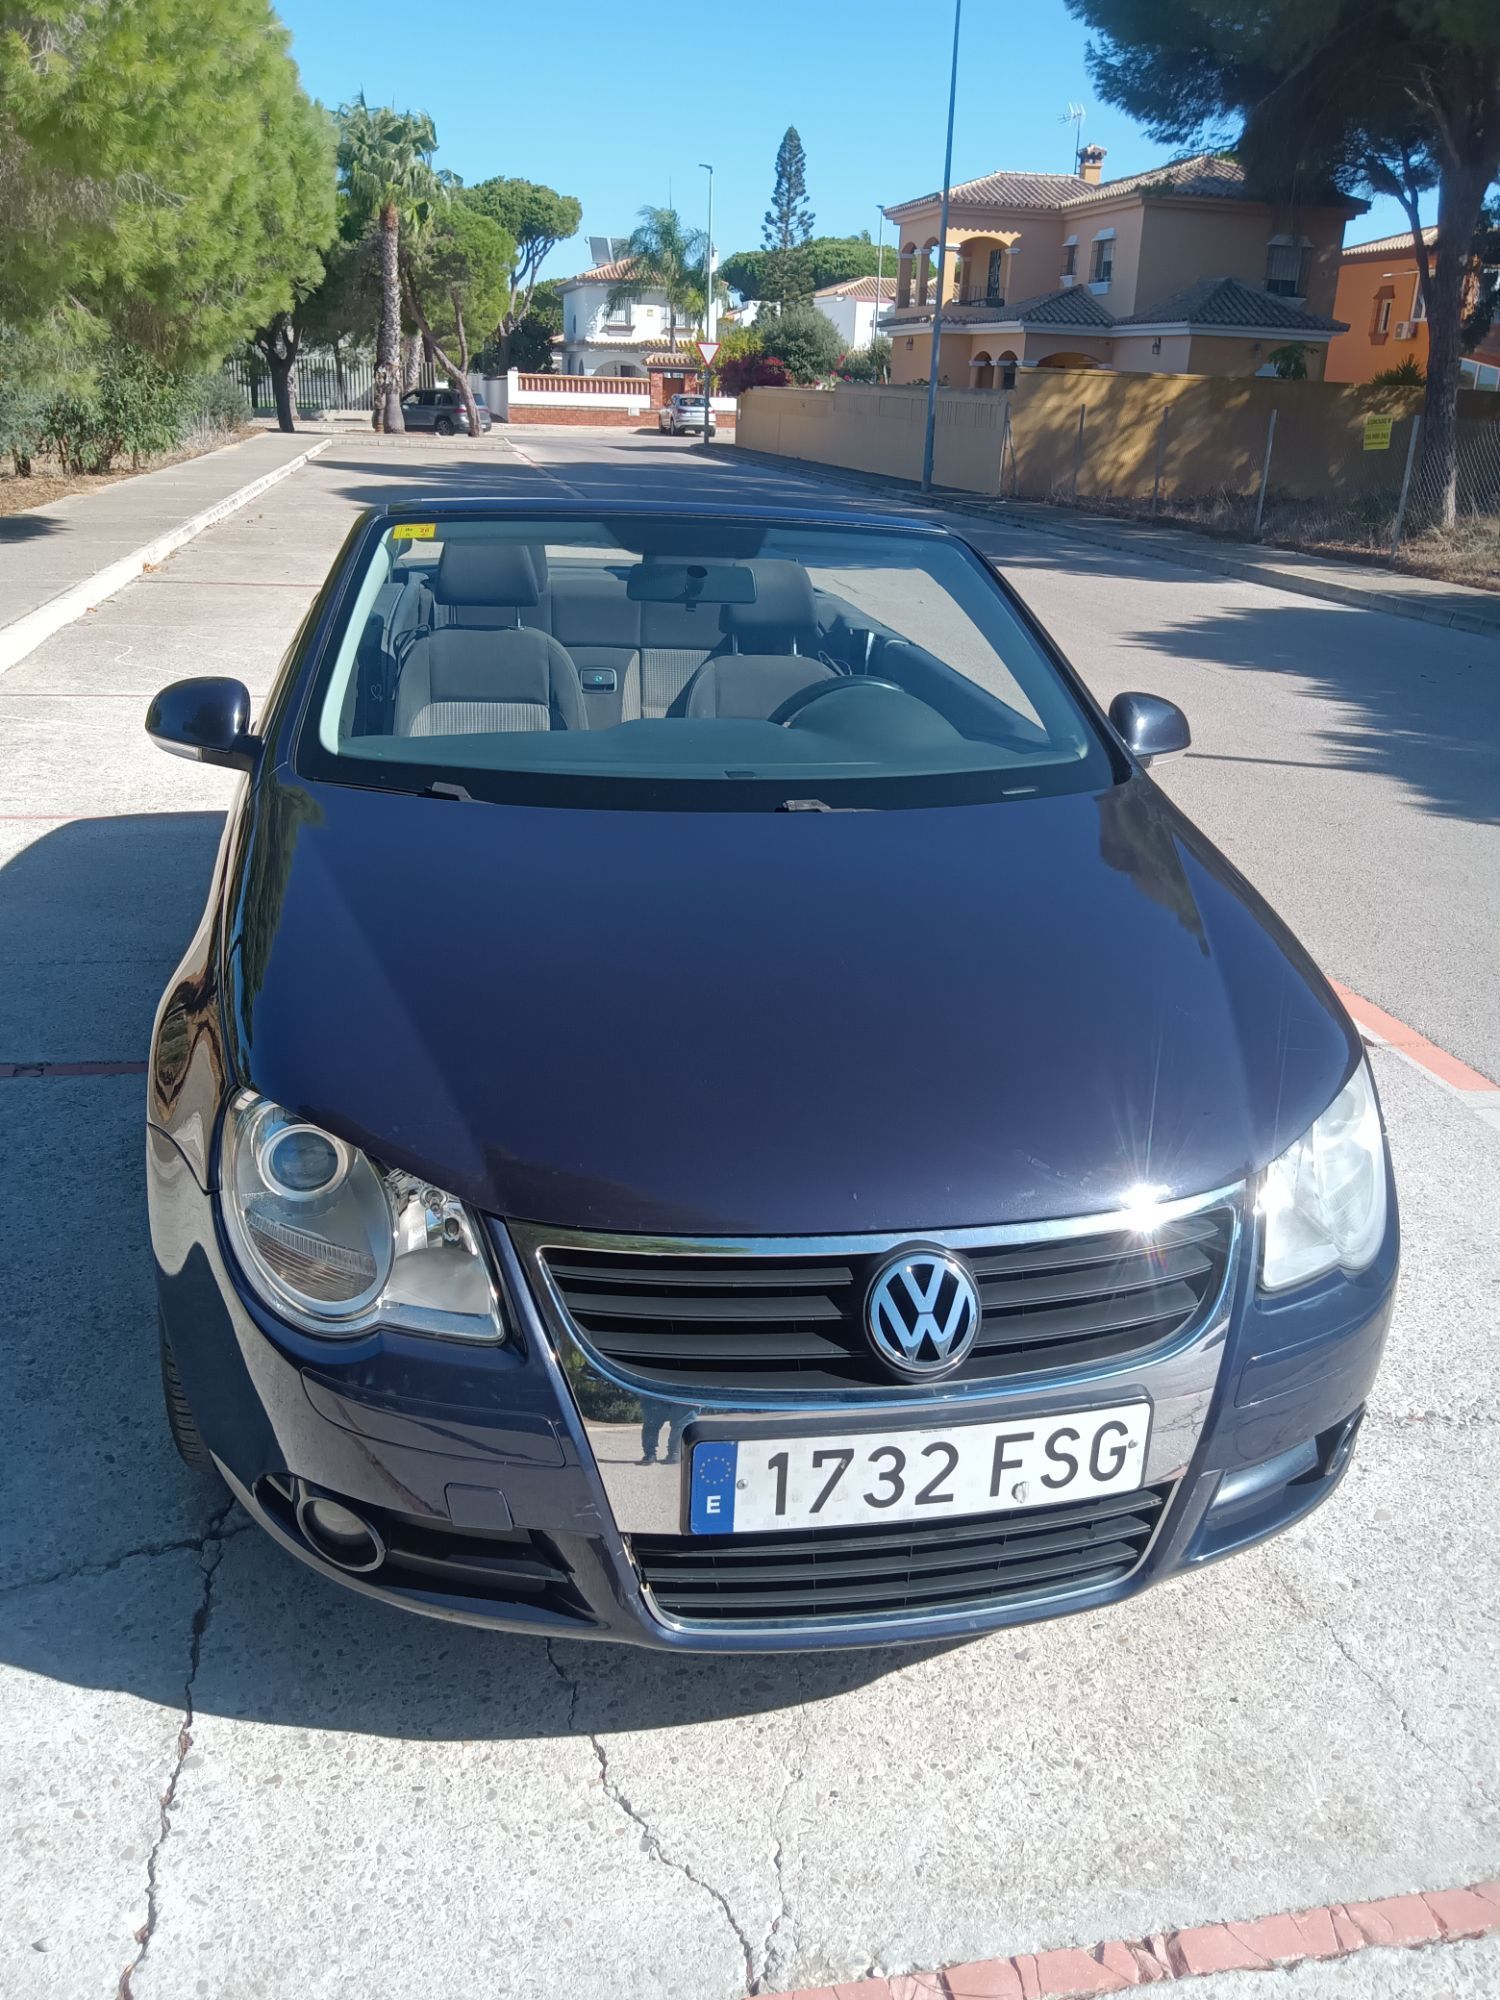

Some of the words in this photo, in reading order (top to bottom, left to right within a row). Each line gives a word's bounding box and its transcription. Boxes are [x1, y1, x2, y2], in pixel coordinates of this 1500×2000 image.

[869, 1254, 977, 1372] VW
[706, 1495, 721, 1514] E
[767, 1441, 959, 1515] 1732
[989, 1420, 1130, 1497] FSG
